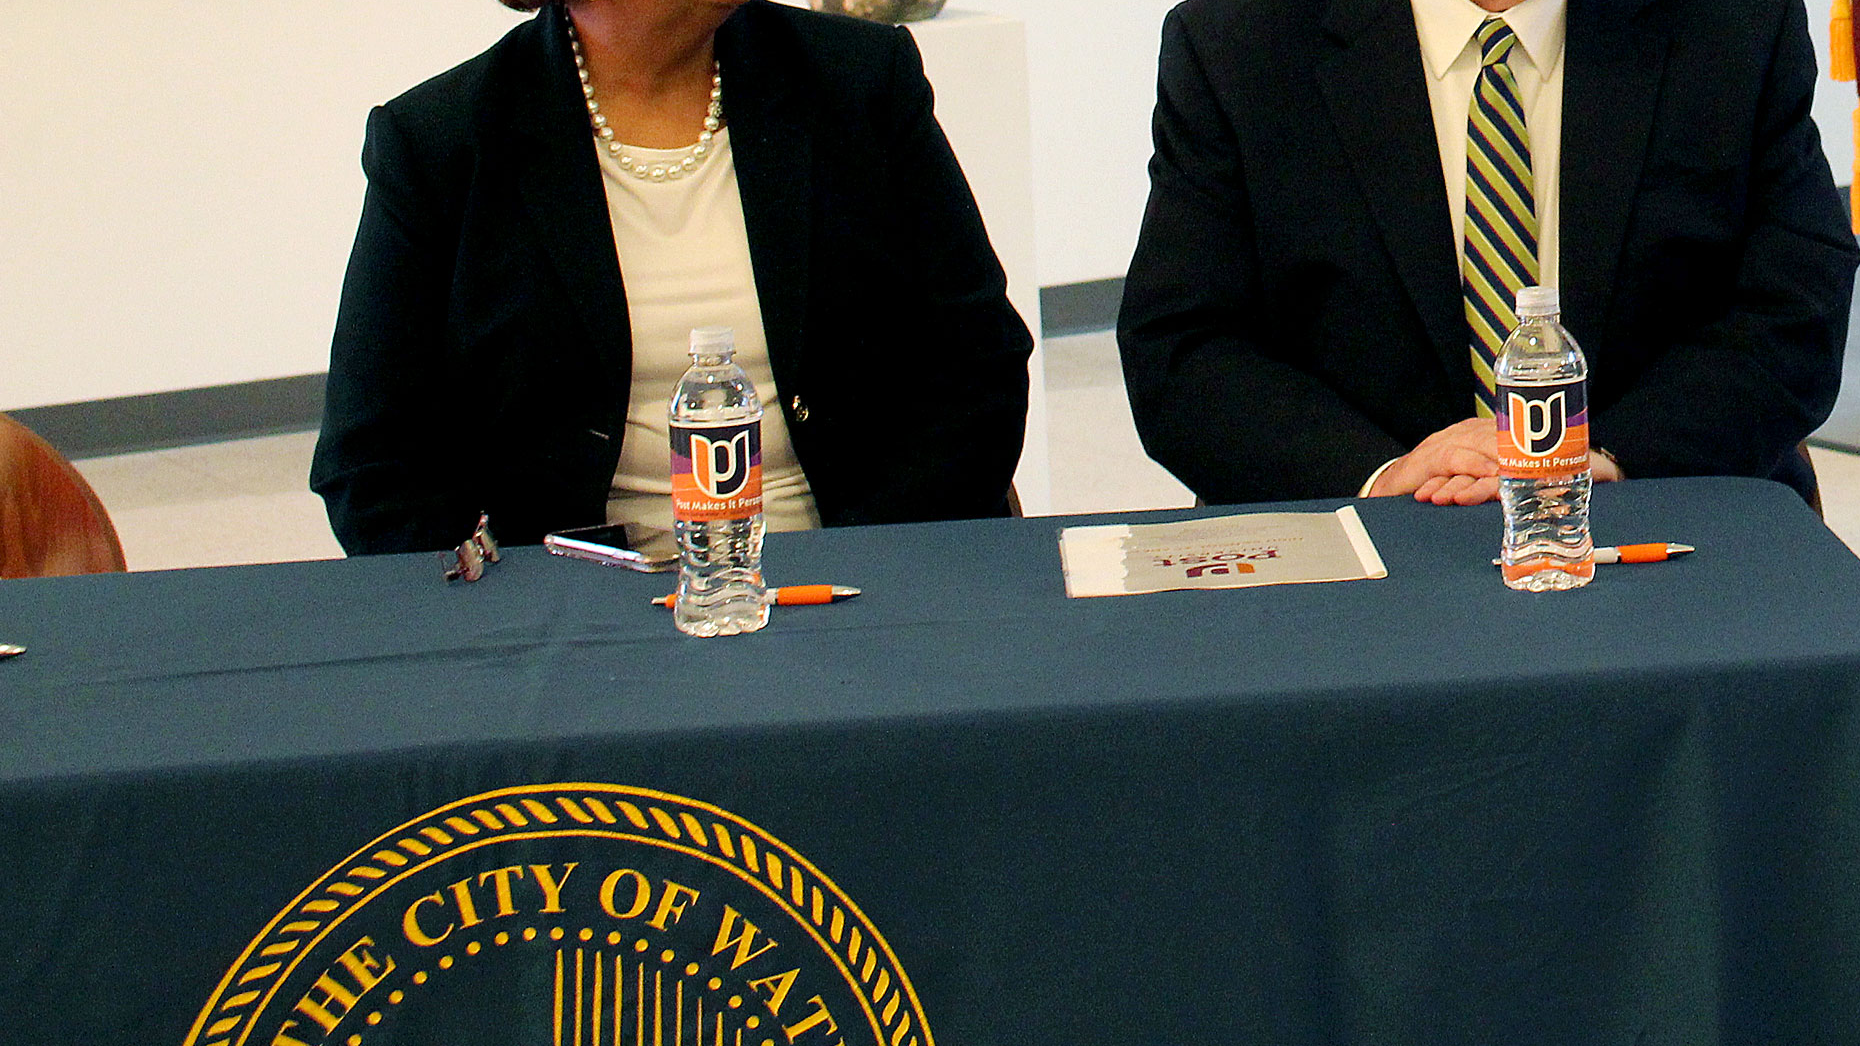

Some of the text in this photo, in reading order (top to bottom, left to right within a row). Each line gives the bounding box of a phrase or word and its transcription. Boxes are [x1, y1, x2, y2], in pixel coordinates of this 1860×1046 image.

[1509, 458, 1540, 468] Makes
[1543, 458, 1550, 467] It
[691, 500, 726, 510] Makes
[729, 499, 736, 509] It
[403, 862, 580, 947] CITY
[600, 868, 700, 932] OF
[711, 904, 845, 1046] WAT
